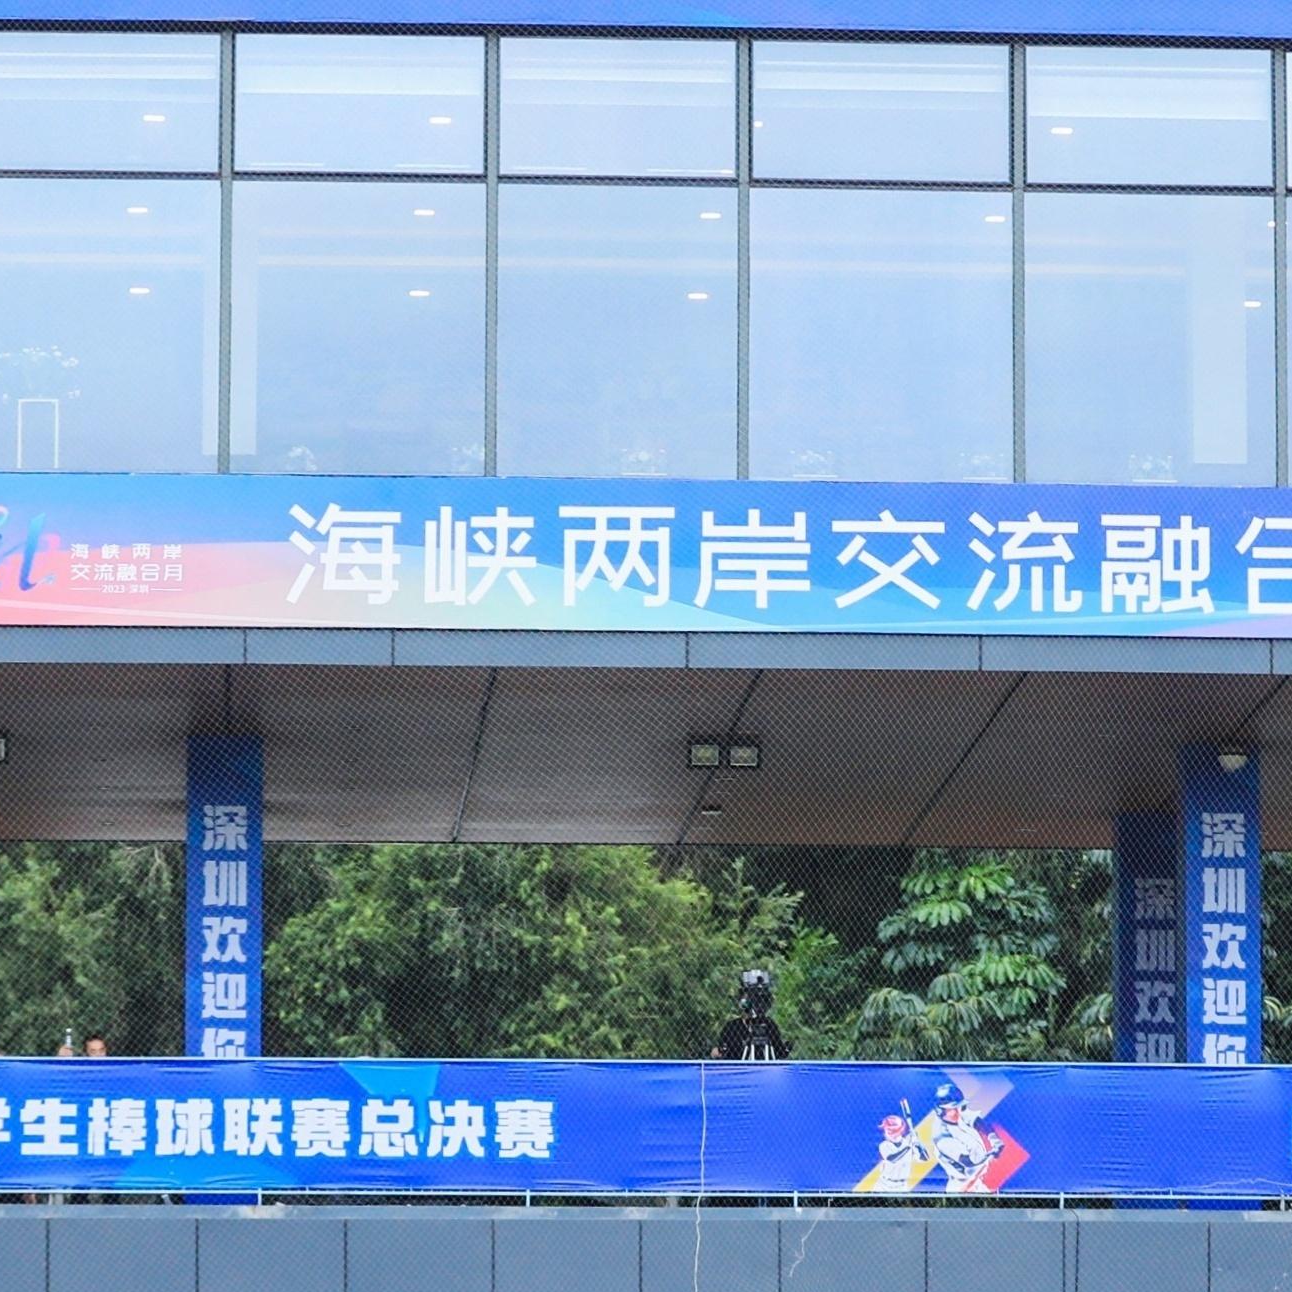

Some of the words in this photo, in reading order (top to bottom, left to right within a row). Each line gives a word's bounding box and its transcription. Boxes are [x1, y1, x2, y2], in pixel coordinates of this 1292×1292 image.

[70, 543, 183, 560] 海峡两岸
[70, 563, 183, 582] 交流融合月
